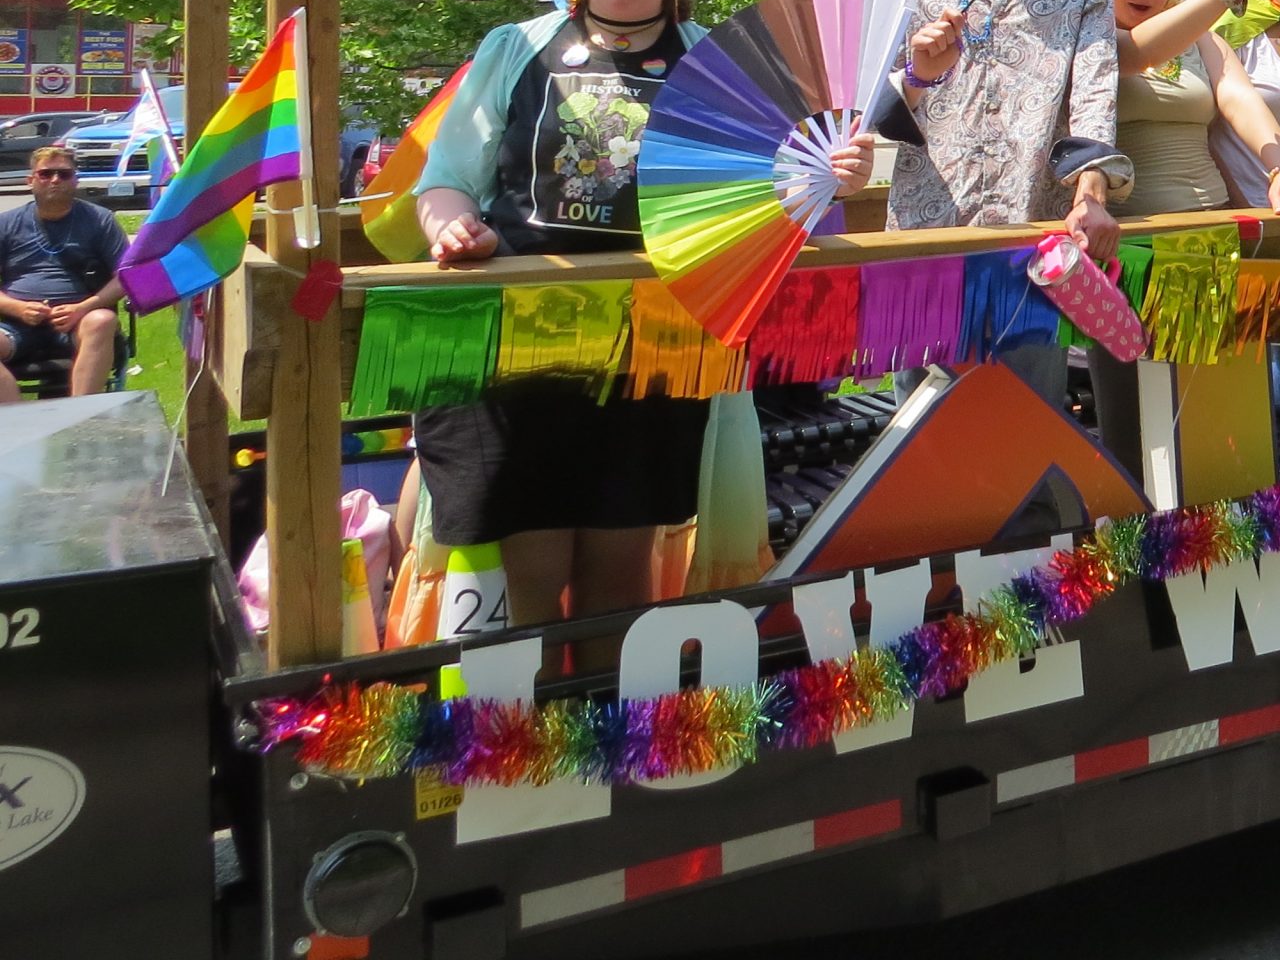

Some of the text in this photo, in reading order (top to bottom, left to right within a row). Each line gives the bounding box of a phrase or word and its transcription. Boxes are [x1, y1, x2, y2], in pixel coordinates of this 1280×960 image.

[581, 84, 642, 97] HISTORY
[602, 78, 619, 87] THE
[557, 201, 614, 224] LOVE
[453, 587, 510, 635] 24
[7, 807, 55, 830] Lake
